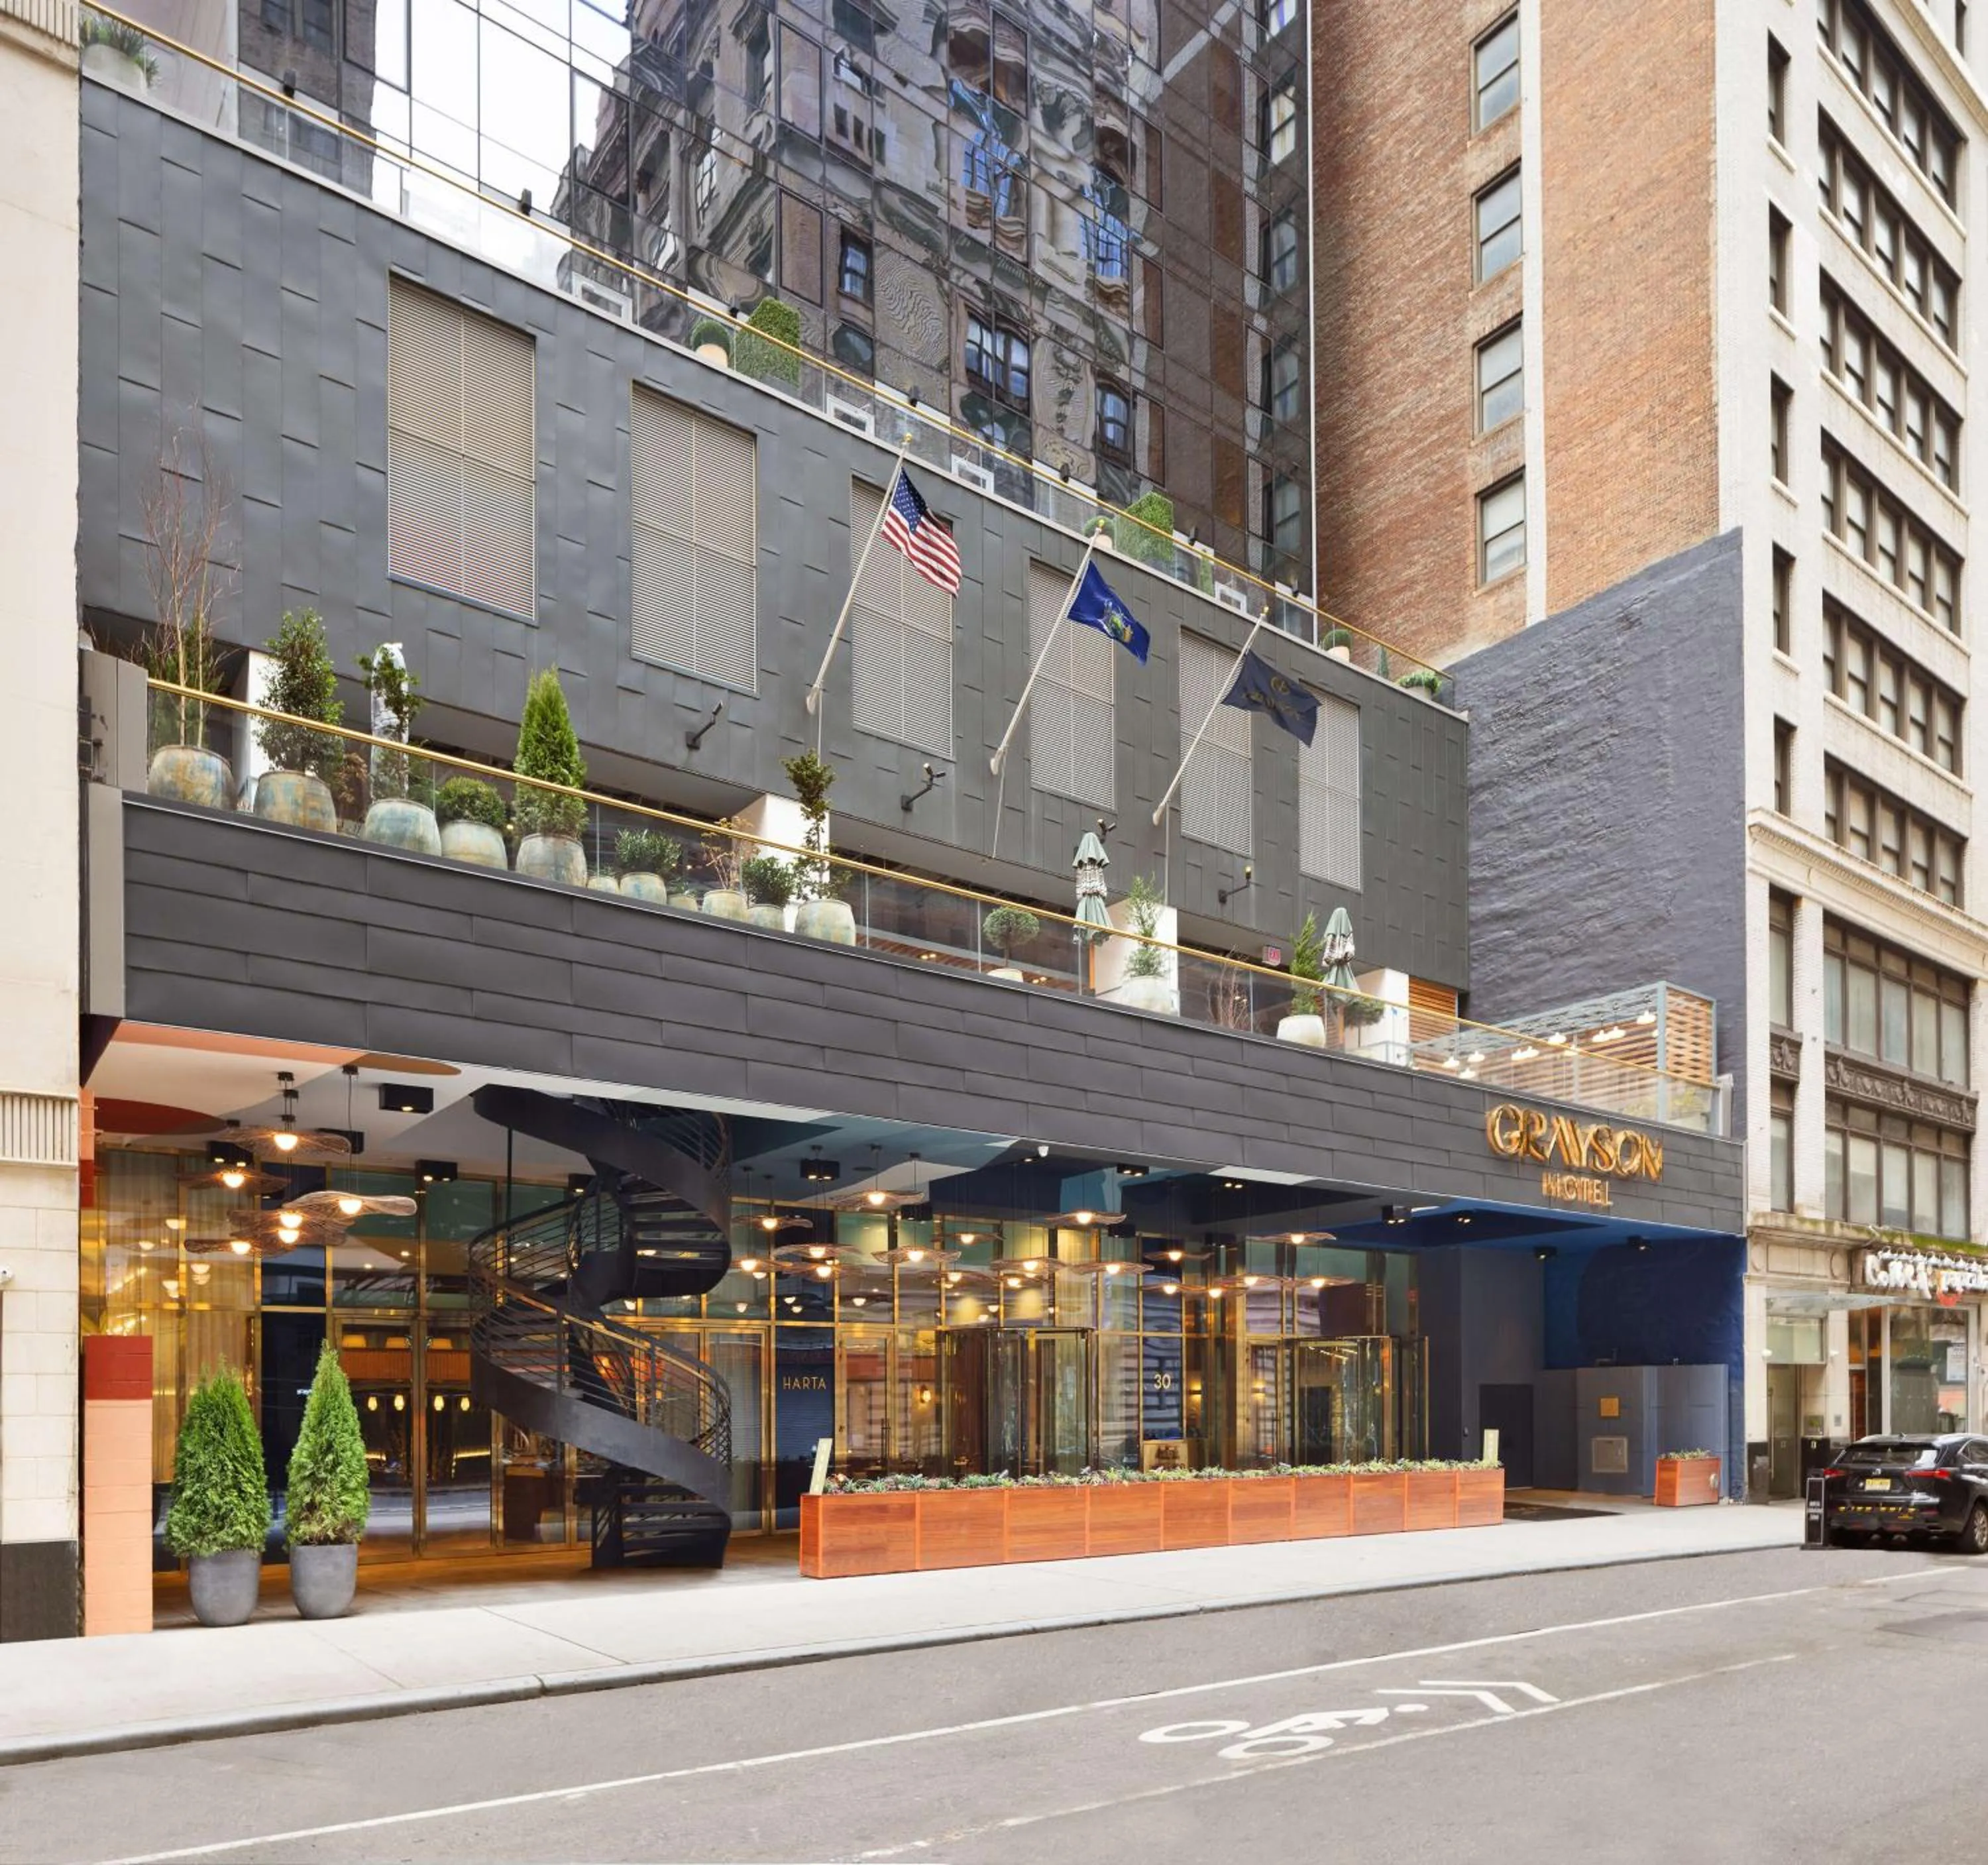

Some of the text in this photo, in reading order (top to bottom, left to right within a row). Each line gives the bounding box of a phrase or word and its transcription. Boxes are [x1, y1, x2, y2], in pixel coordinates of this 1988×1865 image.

[1486, 1103, 1664, 1182] GRAYSON
[1541, 1171, 1613, 1208] HOTEL
[783, 1376, 826, 1390] HARTA
[1154, 1373, 1171, 1390] 30
